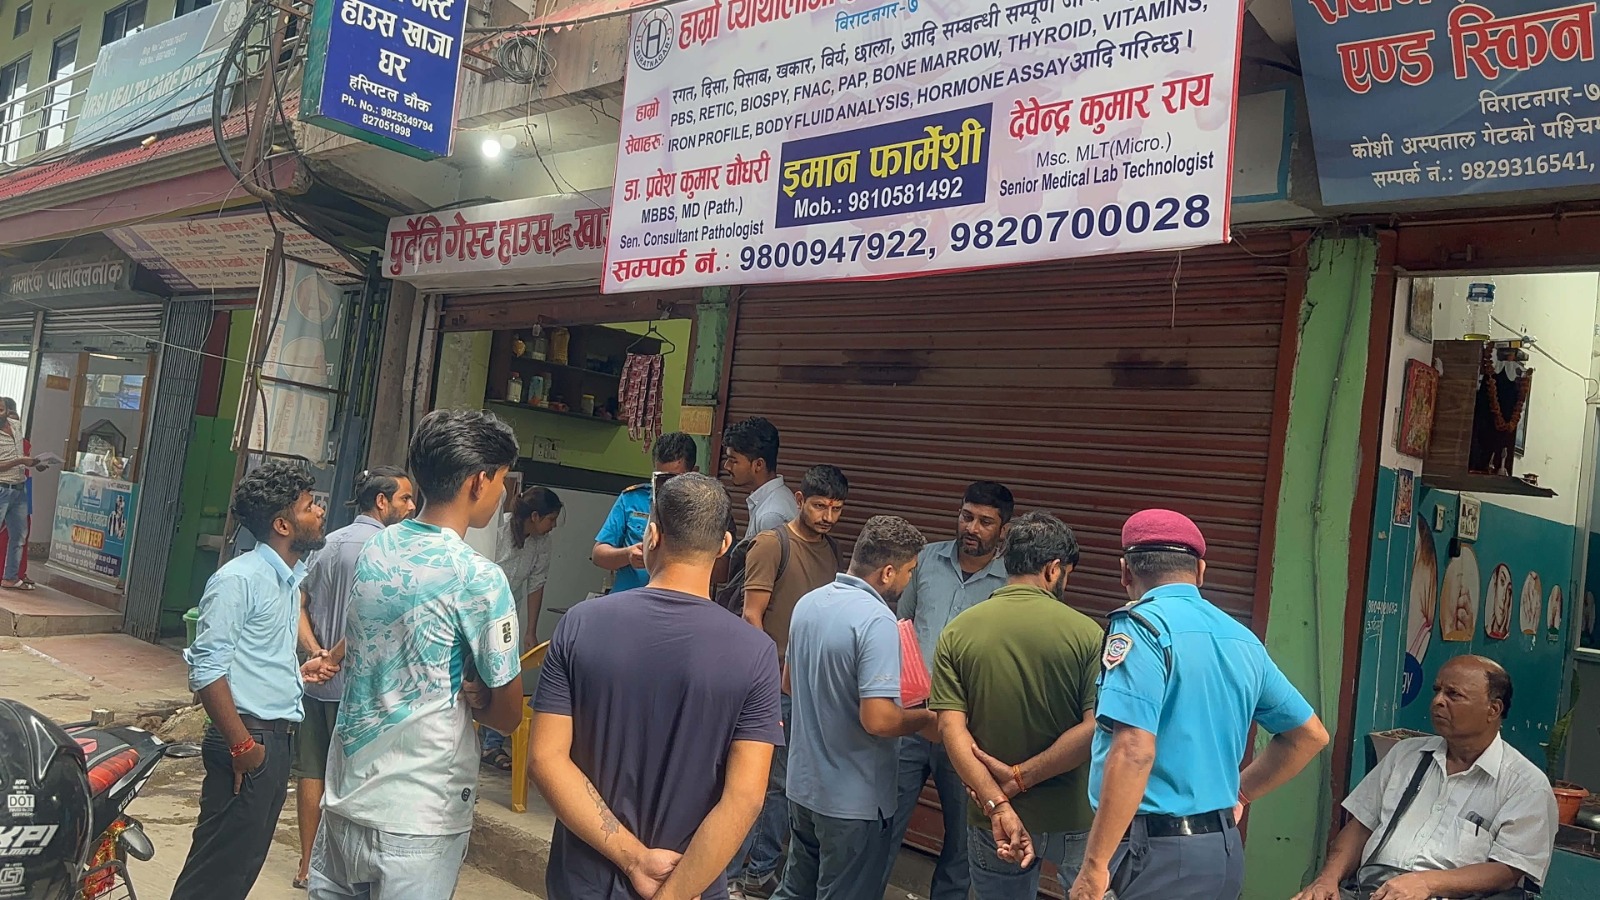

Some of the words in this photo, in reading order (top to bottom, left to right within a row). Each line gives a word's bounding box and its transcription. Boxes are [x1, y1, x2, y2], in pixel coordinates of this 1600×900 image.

[341, 0, 398, 38] हाउस
[402, 18, 454, 59] खाजा
[1337, 29, 1435, 94] एण्ड
[1448, 2, 1597, 80] स्किन
[378, 48, 410, 82] घर
[670, 110, 696, 127] PBS,
[699, 100, 738, 122] RETIC,
[740, 88, 791, 113] BIOSPY,
[793, 78, 834, 102] FNAC,
[838, 71, 869, 93] PAP,
[873, 59, 917, 84] BONE
[921, 39, 1002, 73] MARROW,
[1008, 18, 1097, 53] THYROID,
[1103, 0, 1208, 31] VITAMINS,
[672, 86, 697, 105] रगत,
[701, 76, 728, 99] दिसा,
[733, 66, 772, 91] पिसाब,
[776, 56, 816, 79] खकार,
[821, 42, 849, 68] विर्य,
[855, 37, 895, 64] छाला,
[901, 20, 938, 50] आदि
[942, 2, 1000, 38] सम्बन्धी
[107, 79, 149, 112] HEALTH
[148, 69, 180, 101] CARE
[349, 74, 399, 102] हस्पिटल
[404, 91, 432, 113] चौक
[635, 98, 660, 123] हाम्रो
[668, 134, 696, 153] IRON
[698, 122, 753, 148] PROFILE,
[755, 114, 794, 137] BODY
[794, 107, 834, 131] FLUID
[836, 91, 913, 122] ANALYSIS,
[917, 71, 1004, 105] HORMONE
[1009, 97, 1074, 141] देवेन्द्र
[1079, 84, 1155, 136] कुमार
[1162, 73, 1215, 114] राय
[341, 94, 357, 107] Ph.
[359, 101, 379, 114] No.:
[381, 106, 433, 132] 9825349794
[362, 114, 411, 138] 827051998
[783, 150, 861, 198] इमान
[870, 117, 986, 180] फार्मेशी
[1036, 152, 1070, 169] Msc.
[1076, 131, 1172, 162] MLT(Micro.)
[1351, 133, 1394, 160] कोशी
[1401, 130, 1476, 155] अस्पताल
[1481, 118, 1535, 146] गेटको
[624, 178, 641, 202] डा.
[645, 167, 676, 202] प्रवेश
[680, 165, 722, 199] कुमार
[726, 151, 771, 187] चौधरी
[1000, 177, 1039, 197] Senior
[1041, 167, 1089, 191] Medical
[1093, 166, 1118, 185] Lab
[1122, 150, 1214, 180] Technologist
[1372, 161, 1420, 190] सम्पर्क
[1461, 150, 1595, 182] 9829316541,
[641, 205, 678, 224] MBBS,
[682, 200, 701, 219] MD
[704, 196, 743, 220] (Path.)
[794, 198, 842, 219] Mob.:
[849, 176, 964, 213] 9810581492
[444, 211, 498, 262] गेस्ट
[498, 213, 554, 265] हाउस
[612, 249, 687, 282] सम्पर्क
[740, 227, 936, 271] 9800947922,
[950, 193, 1211, 251] 9820700028
[620, 234, 641, 250] Sen.
[643, 227, 699, 248] Consultant
[701, 219, 764, 245] Pathologist
[72, 526, 103, 549] COUNTER
[10, 796, 33, 807] DOT
